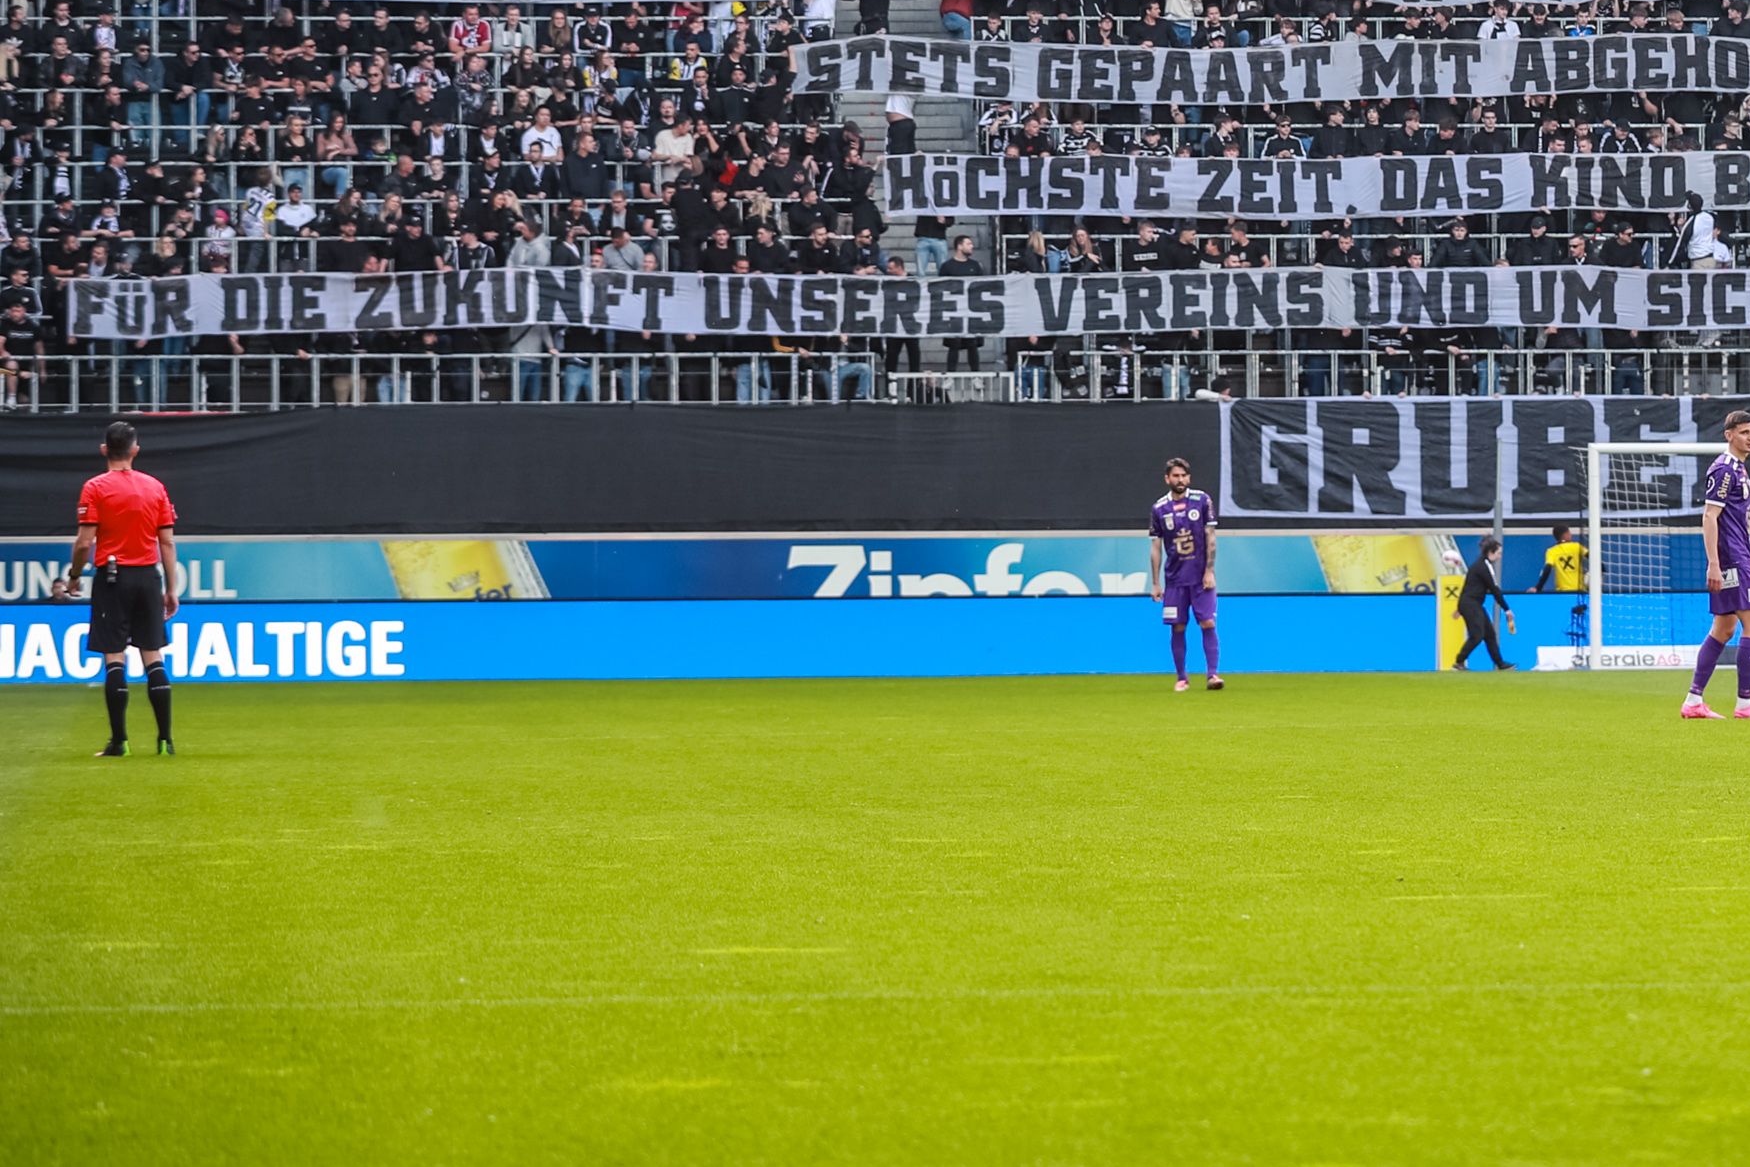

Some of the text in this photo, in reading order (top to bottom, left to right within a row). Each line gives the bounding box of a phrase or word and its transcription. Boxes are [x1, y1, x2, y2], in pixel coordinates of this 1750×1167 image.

[807, 38, 1015, 94] STETS
[1038, 45, 1328, 103] GEPAART
[1361, 41, 1481, 98] MIT
[1381, 153, 1504, 212] DAS
[1531, 152, 1687, 210] KIND
[73, 278, 194, 336] FÜR
[223, 274, 328, 331] DIE
[353, 268, 675, 331] ZUKUNFT
[704, 273, 1005, 334] UNSERES
[1035, 272, 1324, 332] VEREINS
[1353, 270, 1490, 328] UND
[1517, 270, 1618, 325] UM
[0, 621, 405, 678] ACHALTIGE
